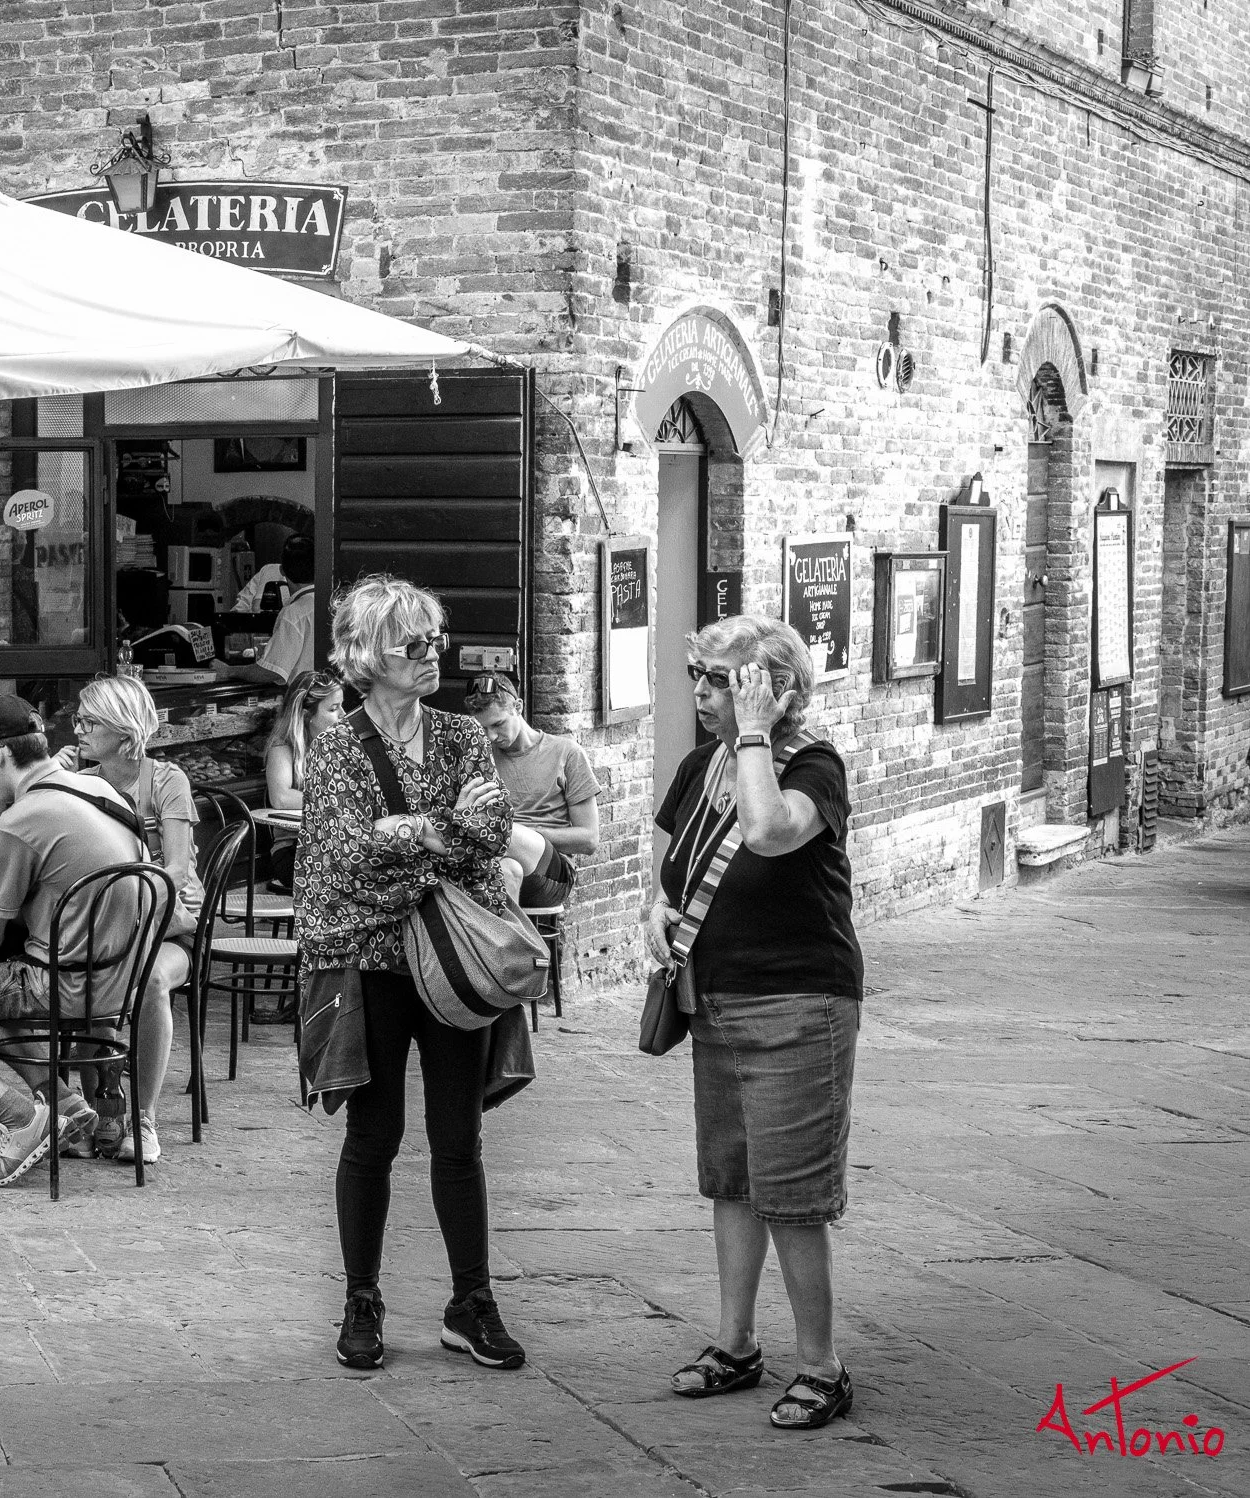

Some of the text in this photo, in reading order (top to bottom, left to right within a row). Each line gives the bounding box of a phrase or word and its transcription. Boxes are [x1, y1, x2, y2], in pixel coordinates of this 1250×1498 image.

[647, 319, 699, 385] GELATERIA
[8, 498, 50, 518] APEROL
[15, 508, 44, 523] SPRITZ
[794, 553, 847, 583] GELATERIA
[610, 579, 641, 608] PASTA
[716, 579, 728, 621] GEL
